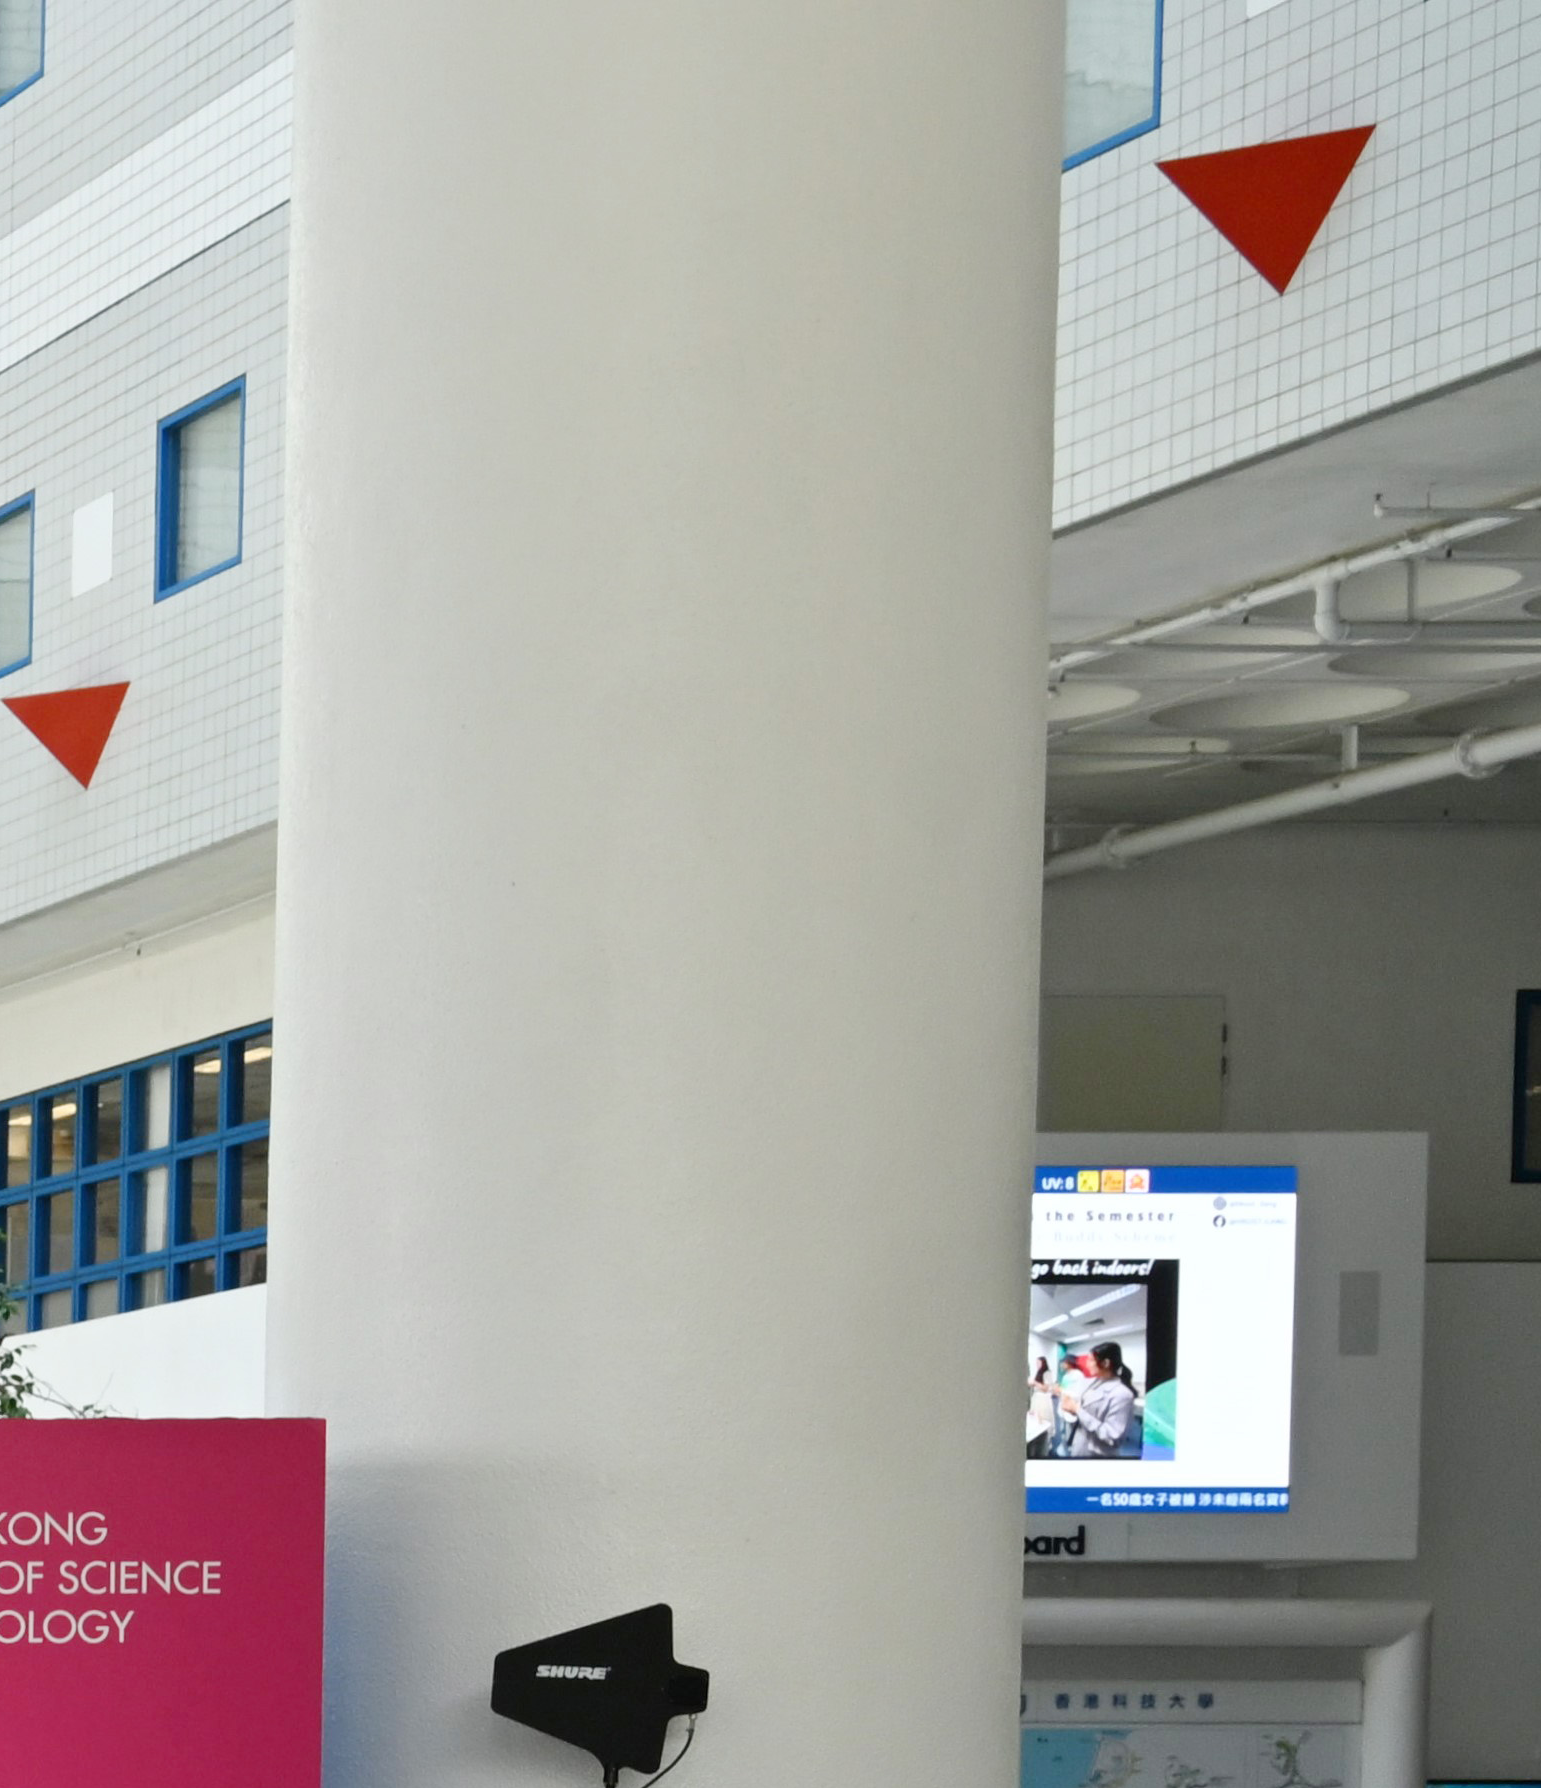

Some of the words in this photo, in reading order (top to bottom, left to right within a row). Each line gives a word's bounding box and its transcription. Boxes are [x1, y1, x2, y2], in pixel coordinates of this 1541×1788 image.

[1046, 1210, 1075, 1222] the
[1086, 1210, 1174, 1222] Semester
[57, 1560, 222, 1595] SCIENCE
[536, 1664, 605, 1680] SHURE
